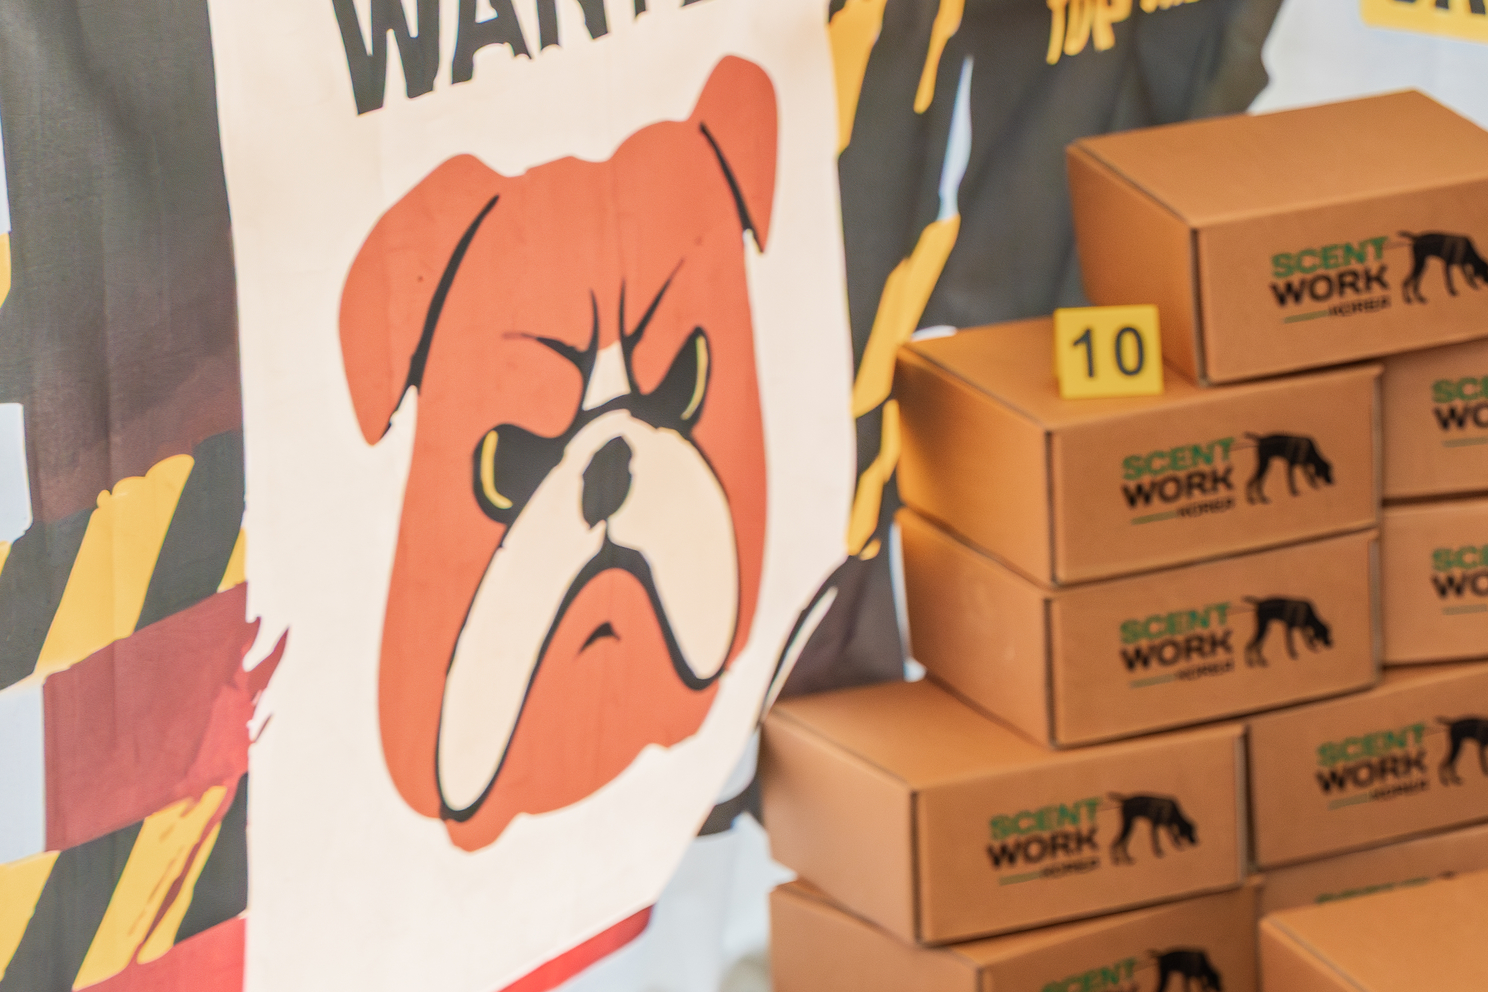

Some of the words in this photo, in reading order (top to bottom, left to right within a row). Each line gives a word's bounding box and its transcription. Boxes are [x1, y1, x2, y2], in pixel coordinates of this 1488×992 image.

[1271, 236, 1389, 279] SCENT
[1269, 264, 1390, 307] WORK
[1072, 326, 1144, 378] 10
[1122, 437, 1235, 481] SCENT
[1122, 465, 1234, 509] WORK
[1120, 601, 1231, 645] SCENT
[1120, 629, 1234, 672] WORK
[1316, 722, 1424, 767] SCENT
[1315, 747, 1428, 793] WORK
[989, 796, 1102, 841] SCENT
[986, 826, 1100, 870] WORK
